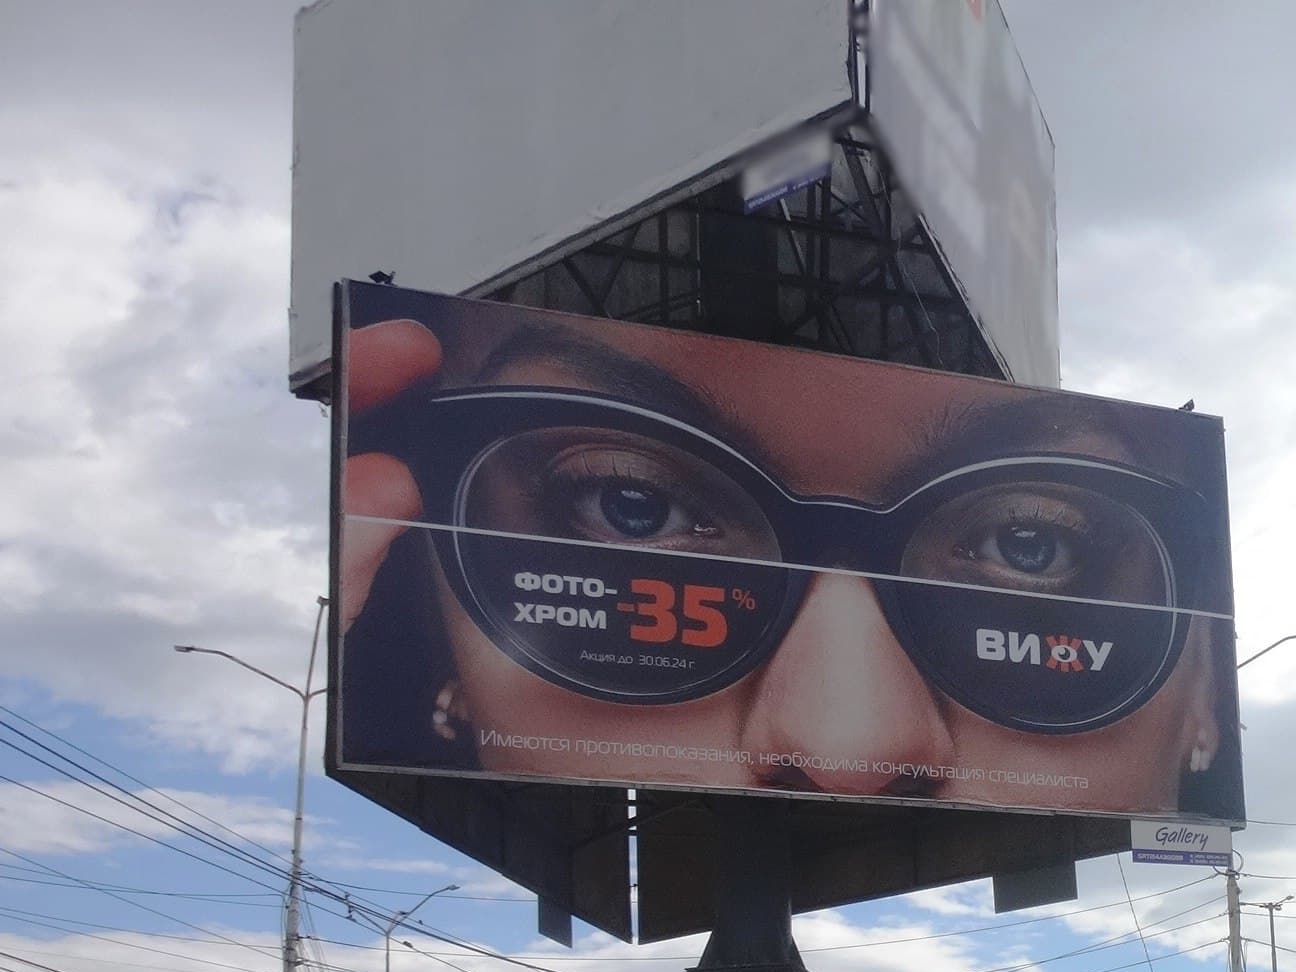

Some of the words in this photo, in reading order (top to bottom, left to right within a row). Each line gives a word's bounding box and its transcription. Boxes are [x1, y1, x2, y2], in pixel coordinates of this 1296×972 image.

[514, 571, 618, 598] ФОТО-
[513, 602, 607, 630] ХРОМ
[616, 578, 728, 648] -35
[580, 650, 616, 663] Акция
[617, 655, 634, 666] до
[638, 655, 687, 669] 30.06.24
[976, 628, 1114, 672] ВИЖУ
[480, 729, 570, 752] Имеются
[575, 738, 754, 765] противопоказания,
[759, 751, 868, 773] необходима
[873, 760, 985, 783] консультация
[988, 768, 1089, 790] специалиста
[1155, 826, 1209, 851] Gallery
